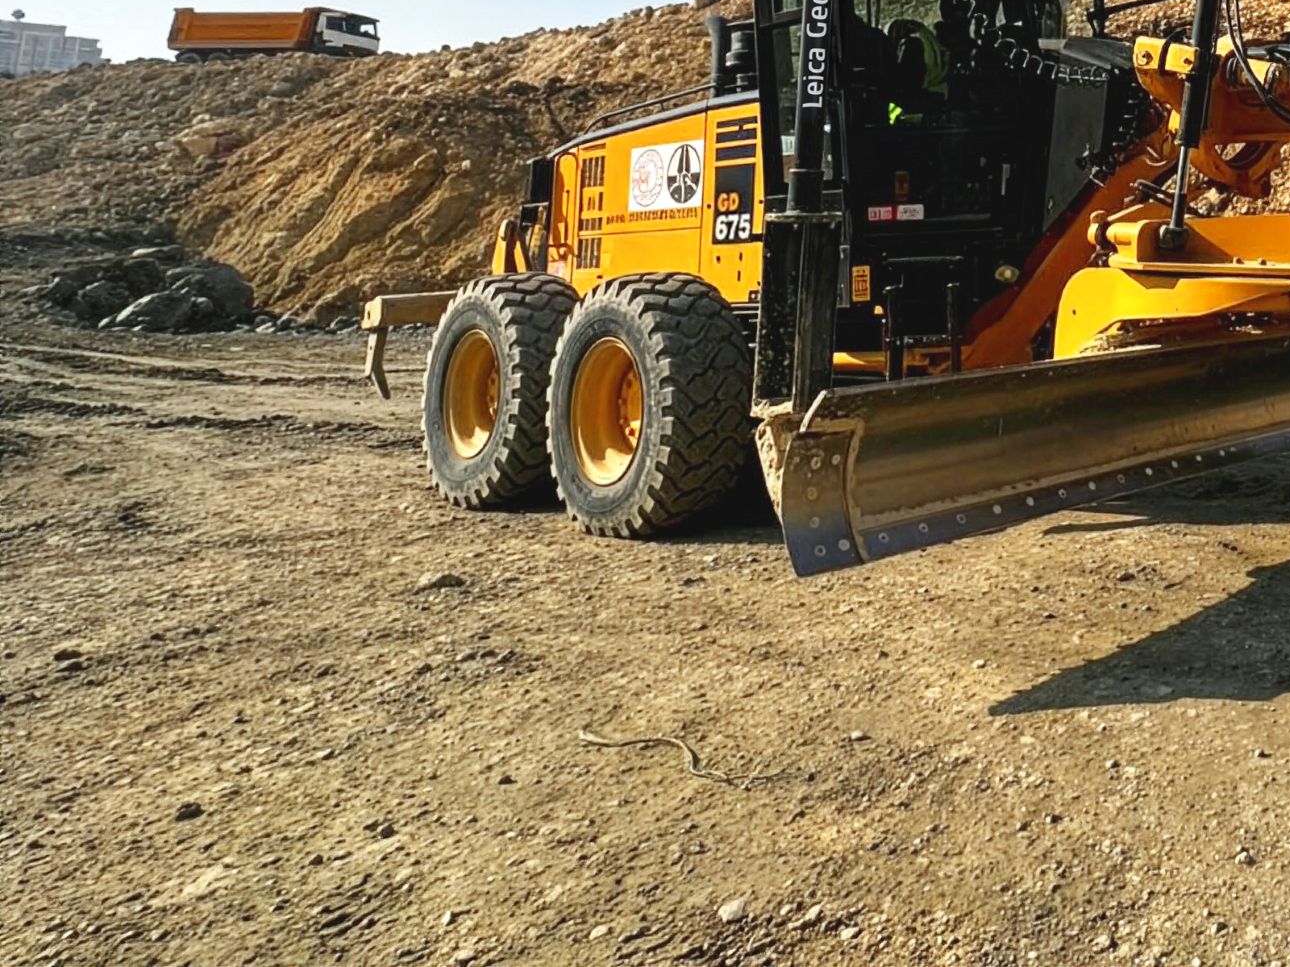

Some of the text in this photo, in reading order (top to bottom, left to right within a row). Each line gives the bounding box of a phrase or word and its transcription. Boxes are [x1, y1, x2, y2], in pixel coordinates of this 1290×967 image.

[802, 48, 826, 109] Leica
[717, 192, 740, 212] GD
[715, 213, 751, 241] 675
